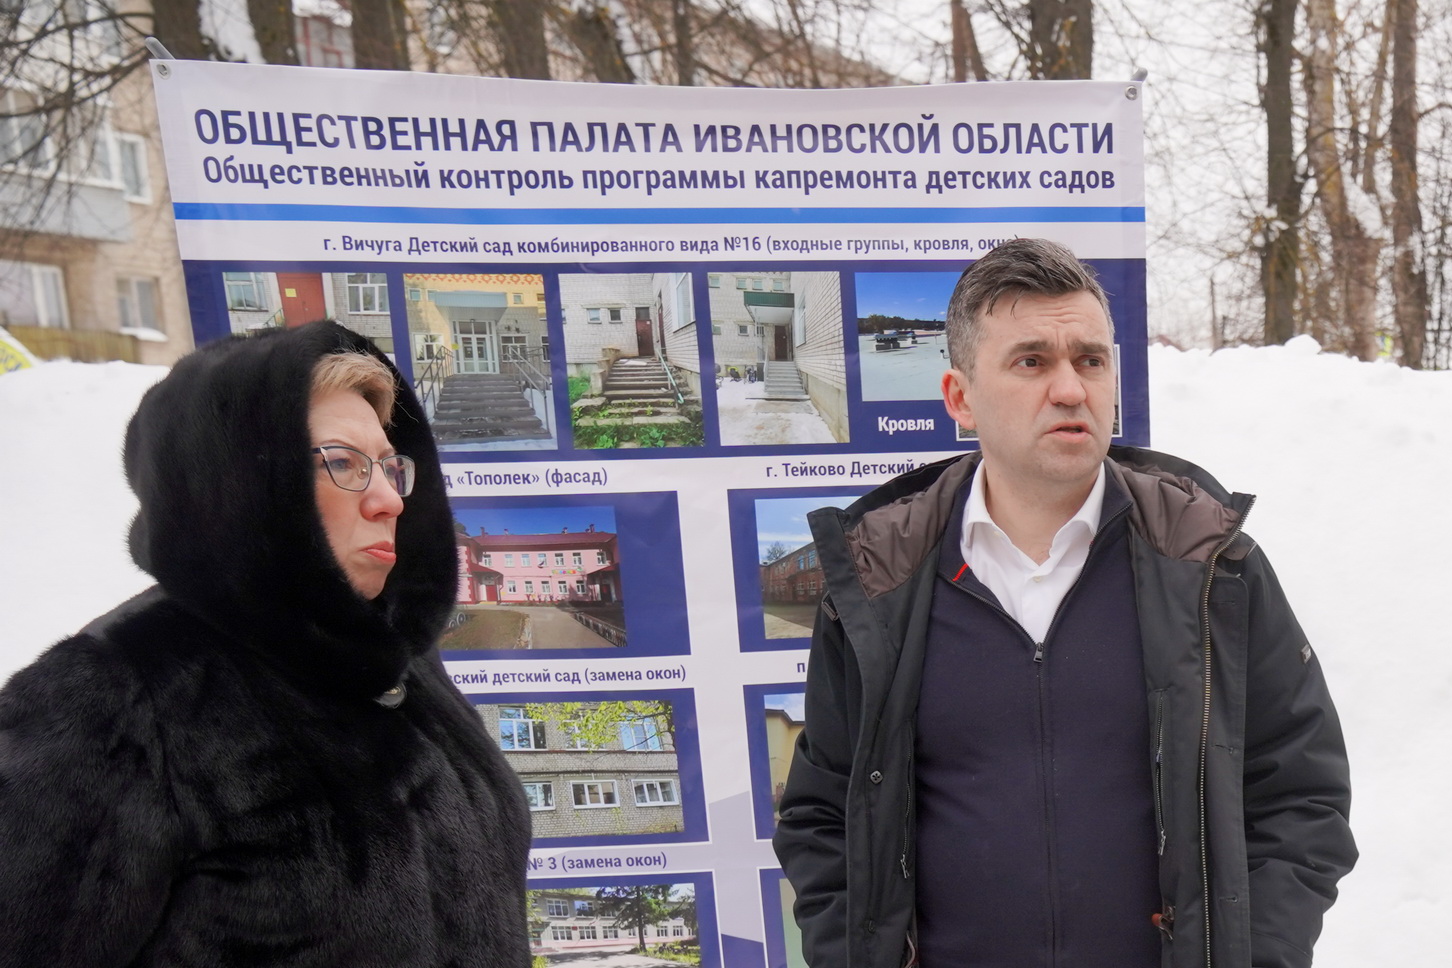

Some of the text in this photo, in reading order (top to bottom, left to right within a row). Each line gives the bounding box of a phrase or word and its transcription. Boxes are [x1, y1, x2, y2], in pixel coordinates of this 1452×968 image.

[194, 108, 1115, 154] ОБЩЕСТВЕННАЯ ПАЛАТА ИВАНОВСКОЙ ОБЛАСТИ
[203, 156, 1115, 196] Общественный контроль программы капремонта детских садов
[324, 238, 336, 250] г.
[342, 235, 402, 255] Вичуга
[408, 237, 478, 255] Детский
[483, 241, 513, 256] сад
[517, 237, 674, 256] комбинированного
[680, 240, 719, 254] вида
[724, 236, 761, 251] №16
[767, 235, 842, 254] (входные
[847, 239, 908, 254] группы,
[914, 238, 973, 254] кровля,
[878, 416, 934, 435] Кровля
[457, 471, 540, 486] «Тополек»
[545, 467, 608, 487] (фасад)
[766, 459, 915, 478] г. Тейково Детский
[448, 664, 687, 685] ский детский сад (замена окон)
[528, 851, 668, 873] № 3 (замена окон)
